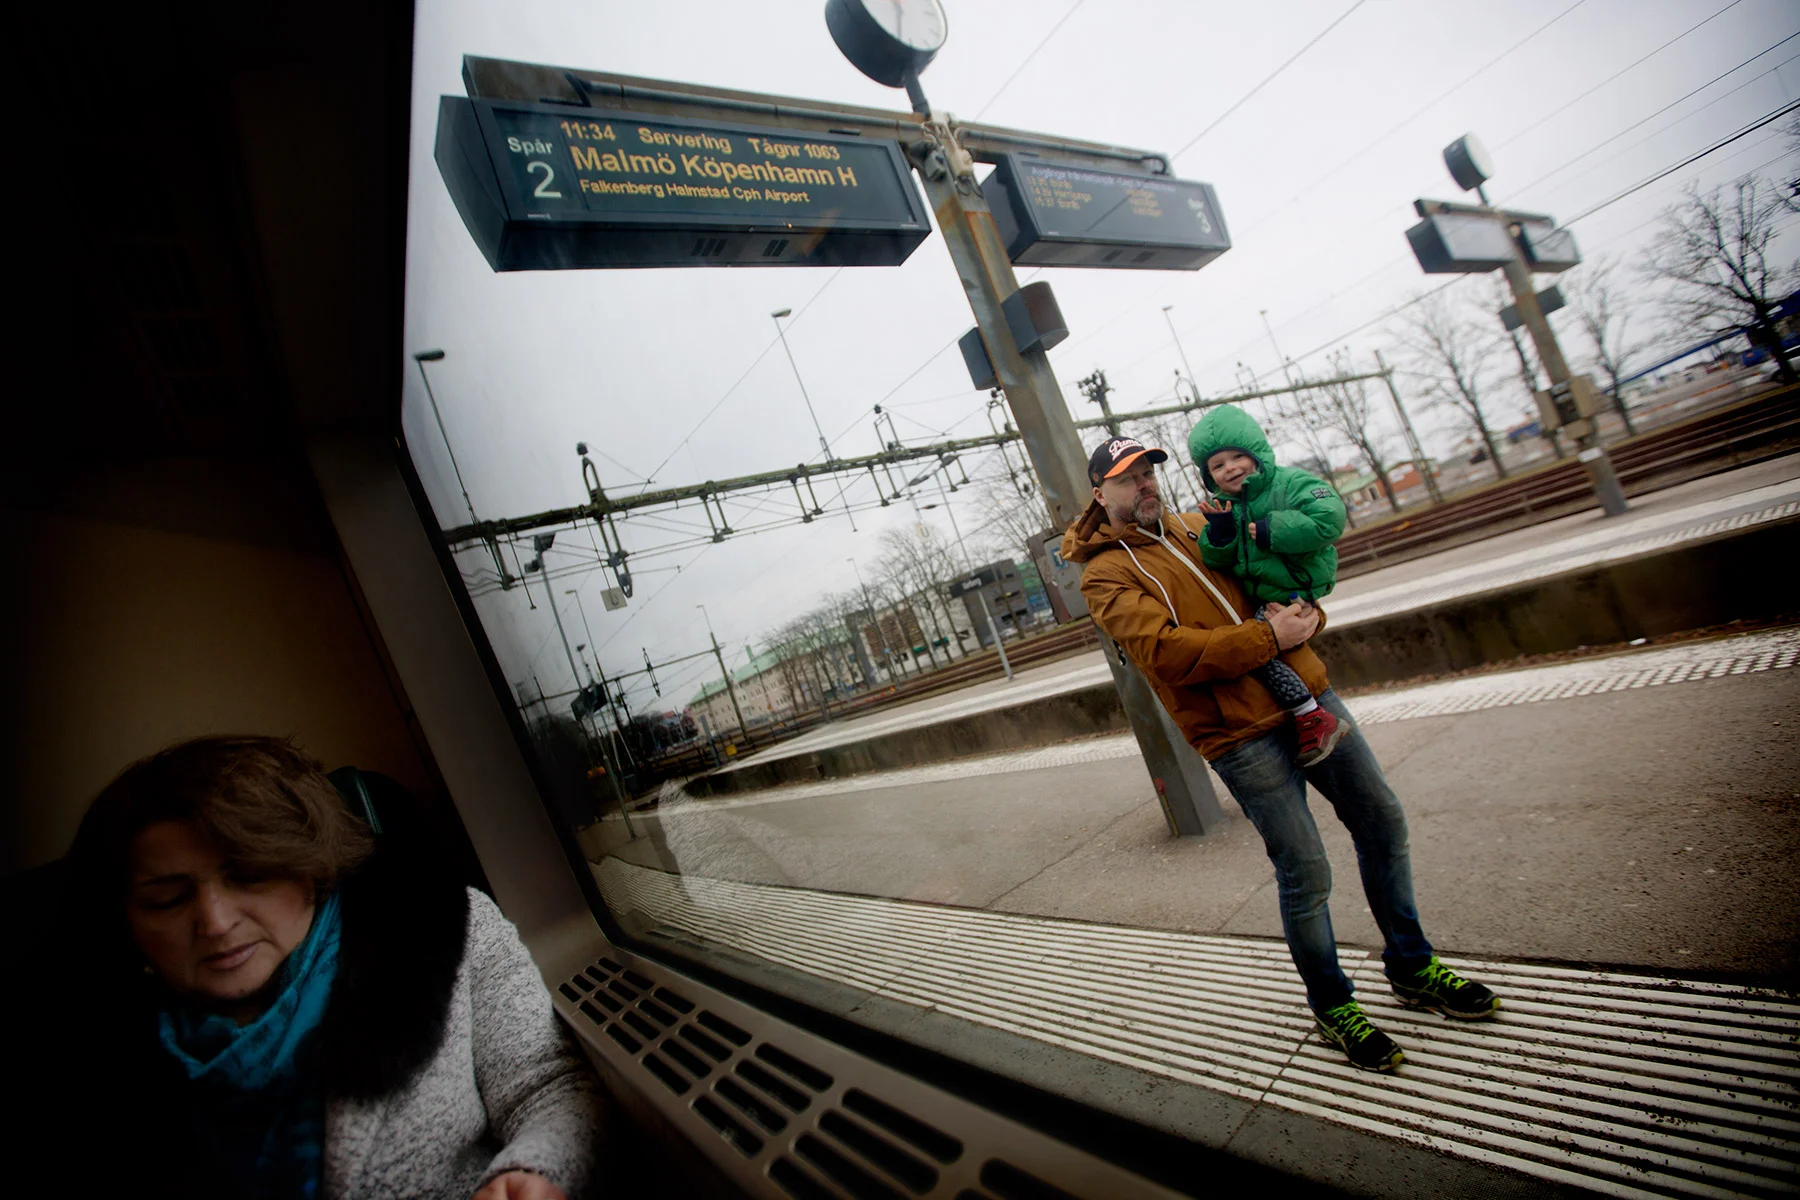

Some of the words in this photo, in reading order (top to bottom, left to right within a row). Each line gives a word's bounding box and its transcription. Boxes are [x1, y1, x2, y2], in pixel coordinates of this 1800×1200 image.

[507, 136, 553, 157] Spår
[560, 120, 617, 141] 11:34
[638, 127, 732, 154] Servering
[747, 138, 801, 159] Tågnr
[804, 143, 840, 160] 1063
[526, 161, 562, 198] 2
[569, 145, 677, 175] Malmö
[680, 153, 836, 185] Köpenhamn
[836, 165, 858, 187] H
[579, 178, 666, 198] Falkenberg
[665, 182, 731, 199] Halmstad
[732, 186, 762, 202] Cph
[765, 187, 811, 204] Airport
